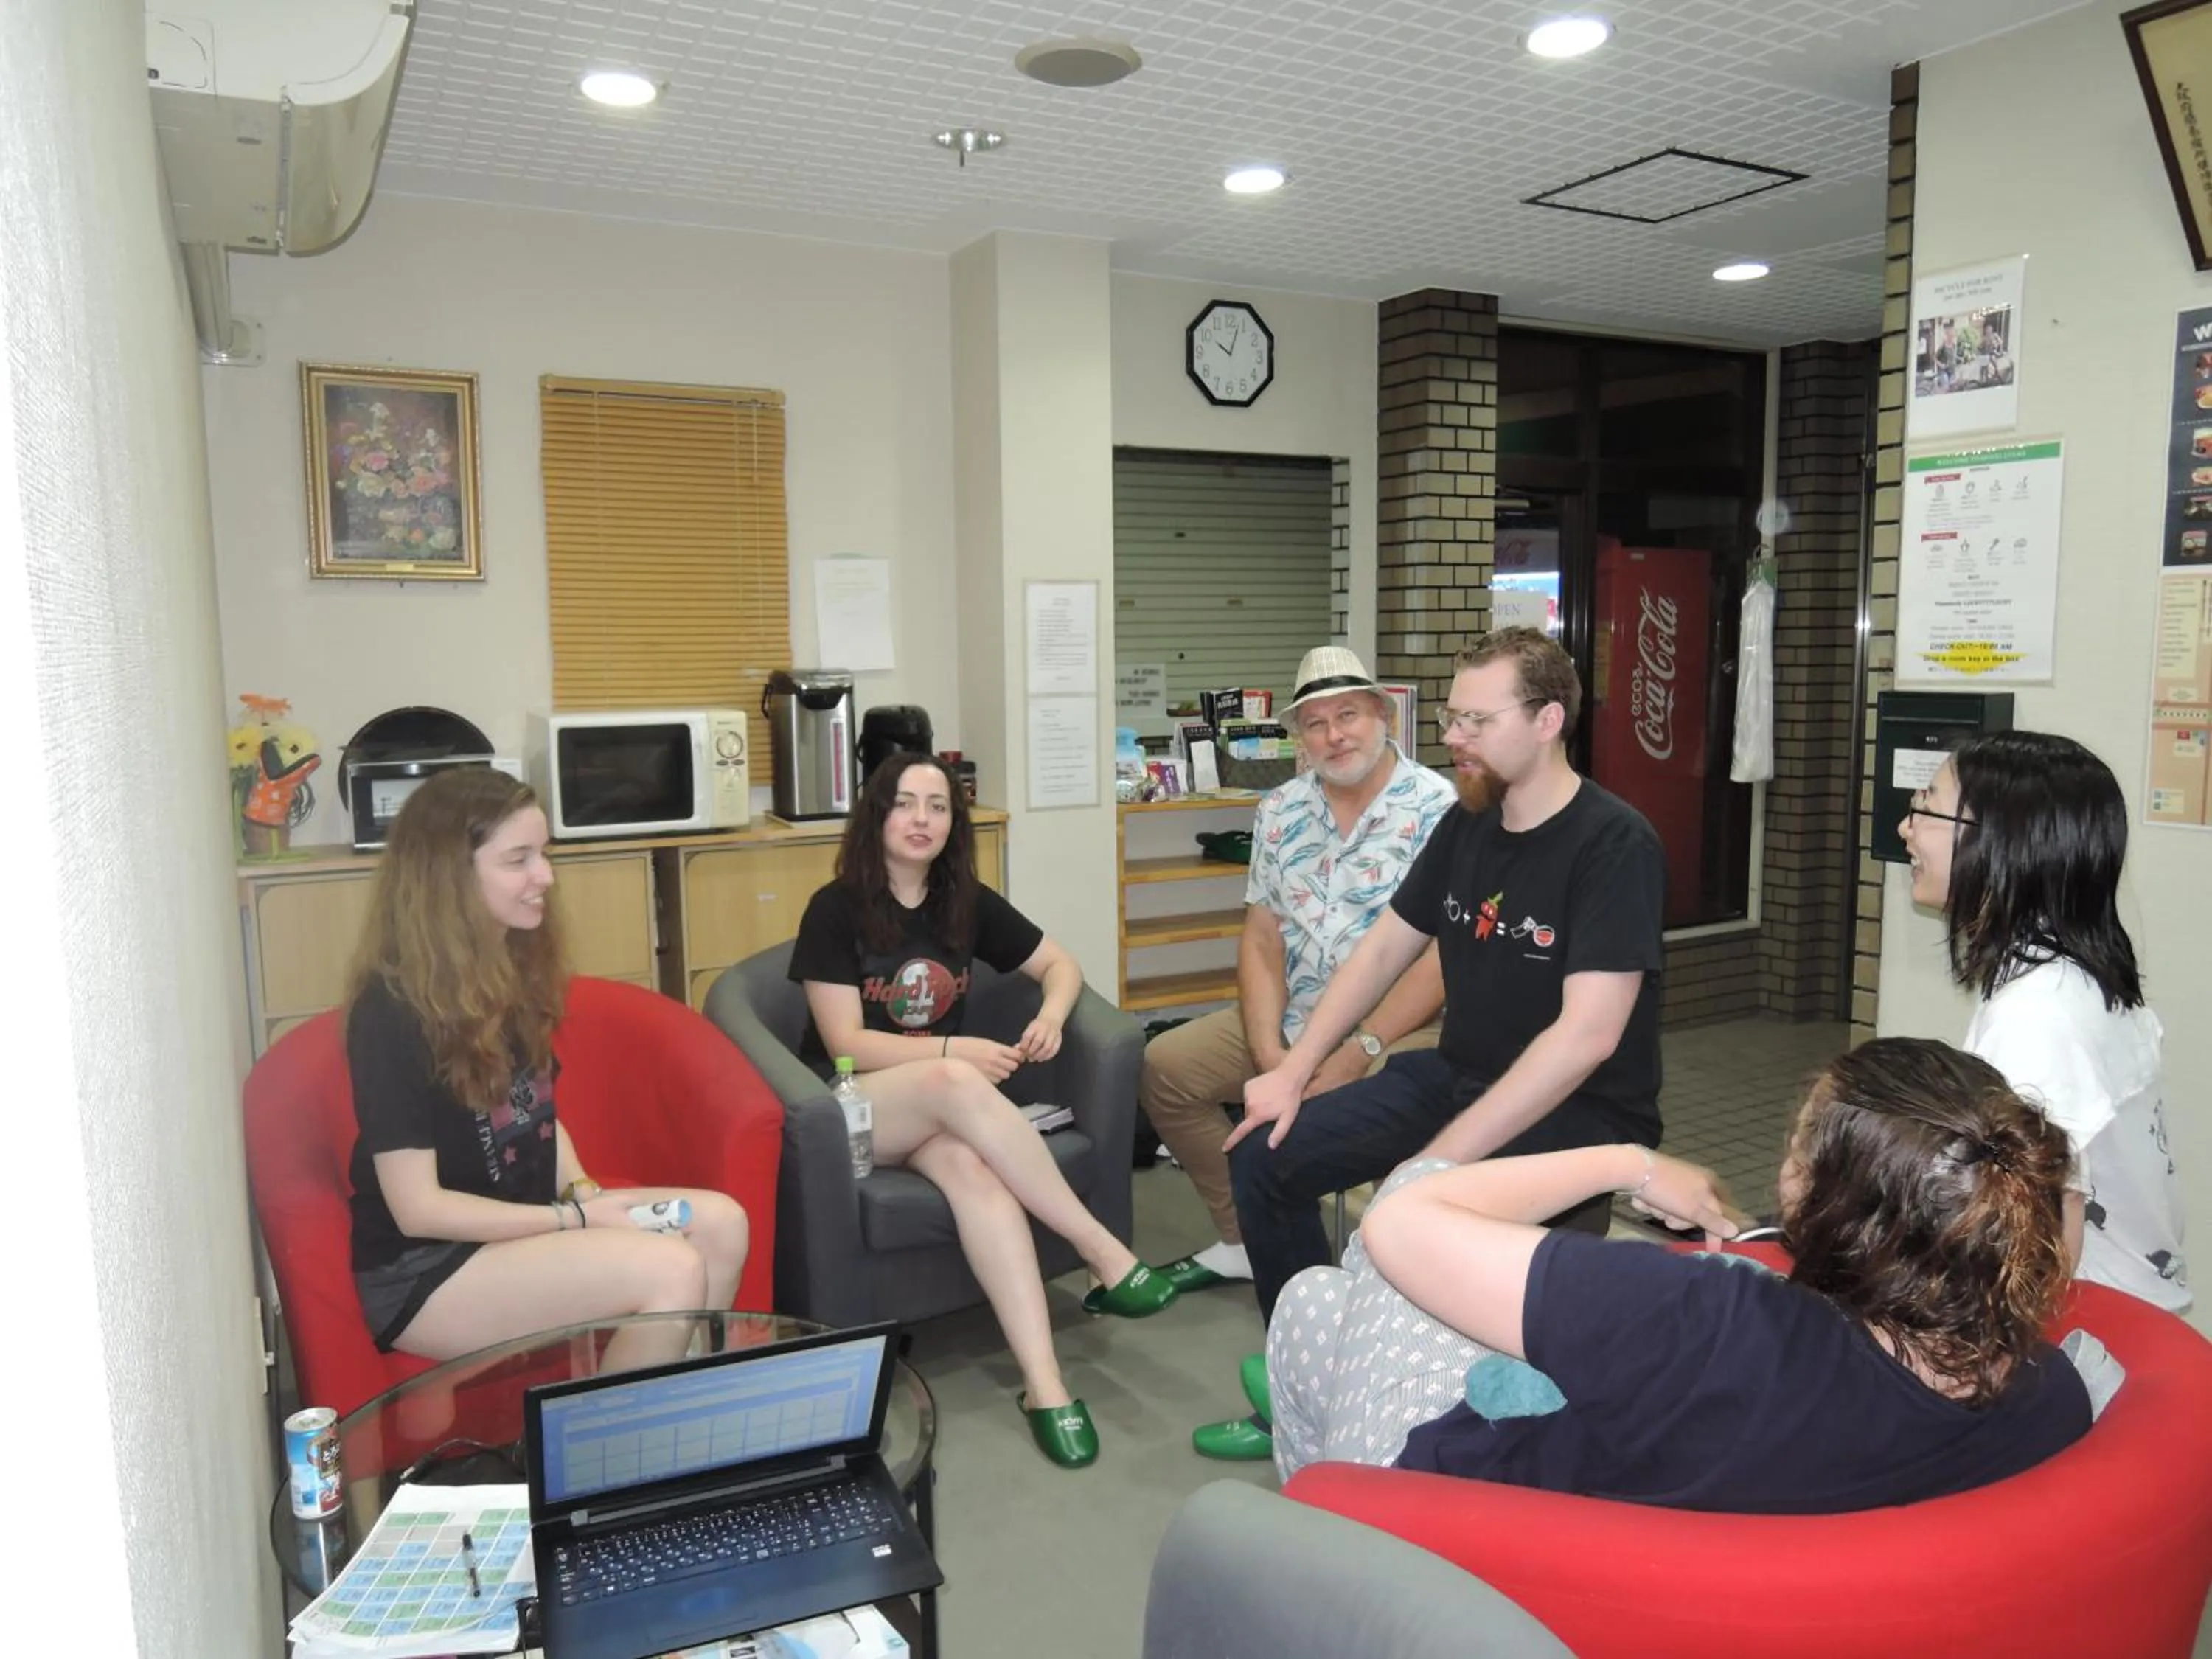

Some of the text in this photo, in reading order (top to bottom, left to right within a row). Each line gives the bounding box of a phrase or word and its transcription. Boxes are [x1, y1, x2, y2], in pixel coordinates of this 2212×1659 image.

[1201, 328, 1212, 344] 10
[1195, 344, 1203, 360] 9
[1255, 349, 1264, 365] 3
[1239, 378, 1248, 393] 5
[1635, 585, 1679, 760] Coca-Cola
